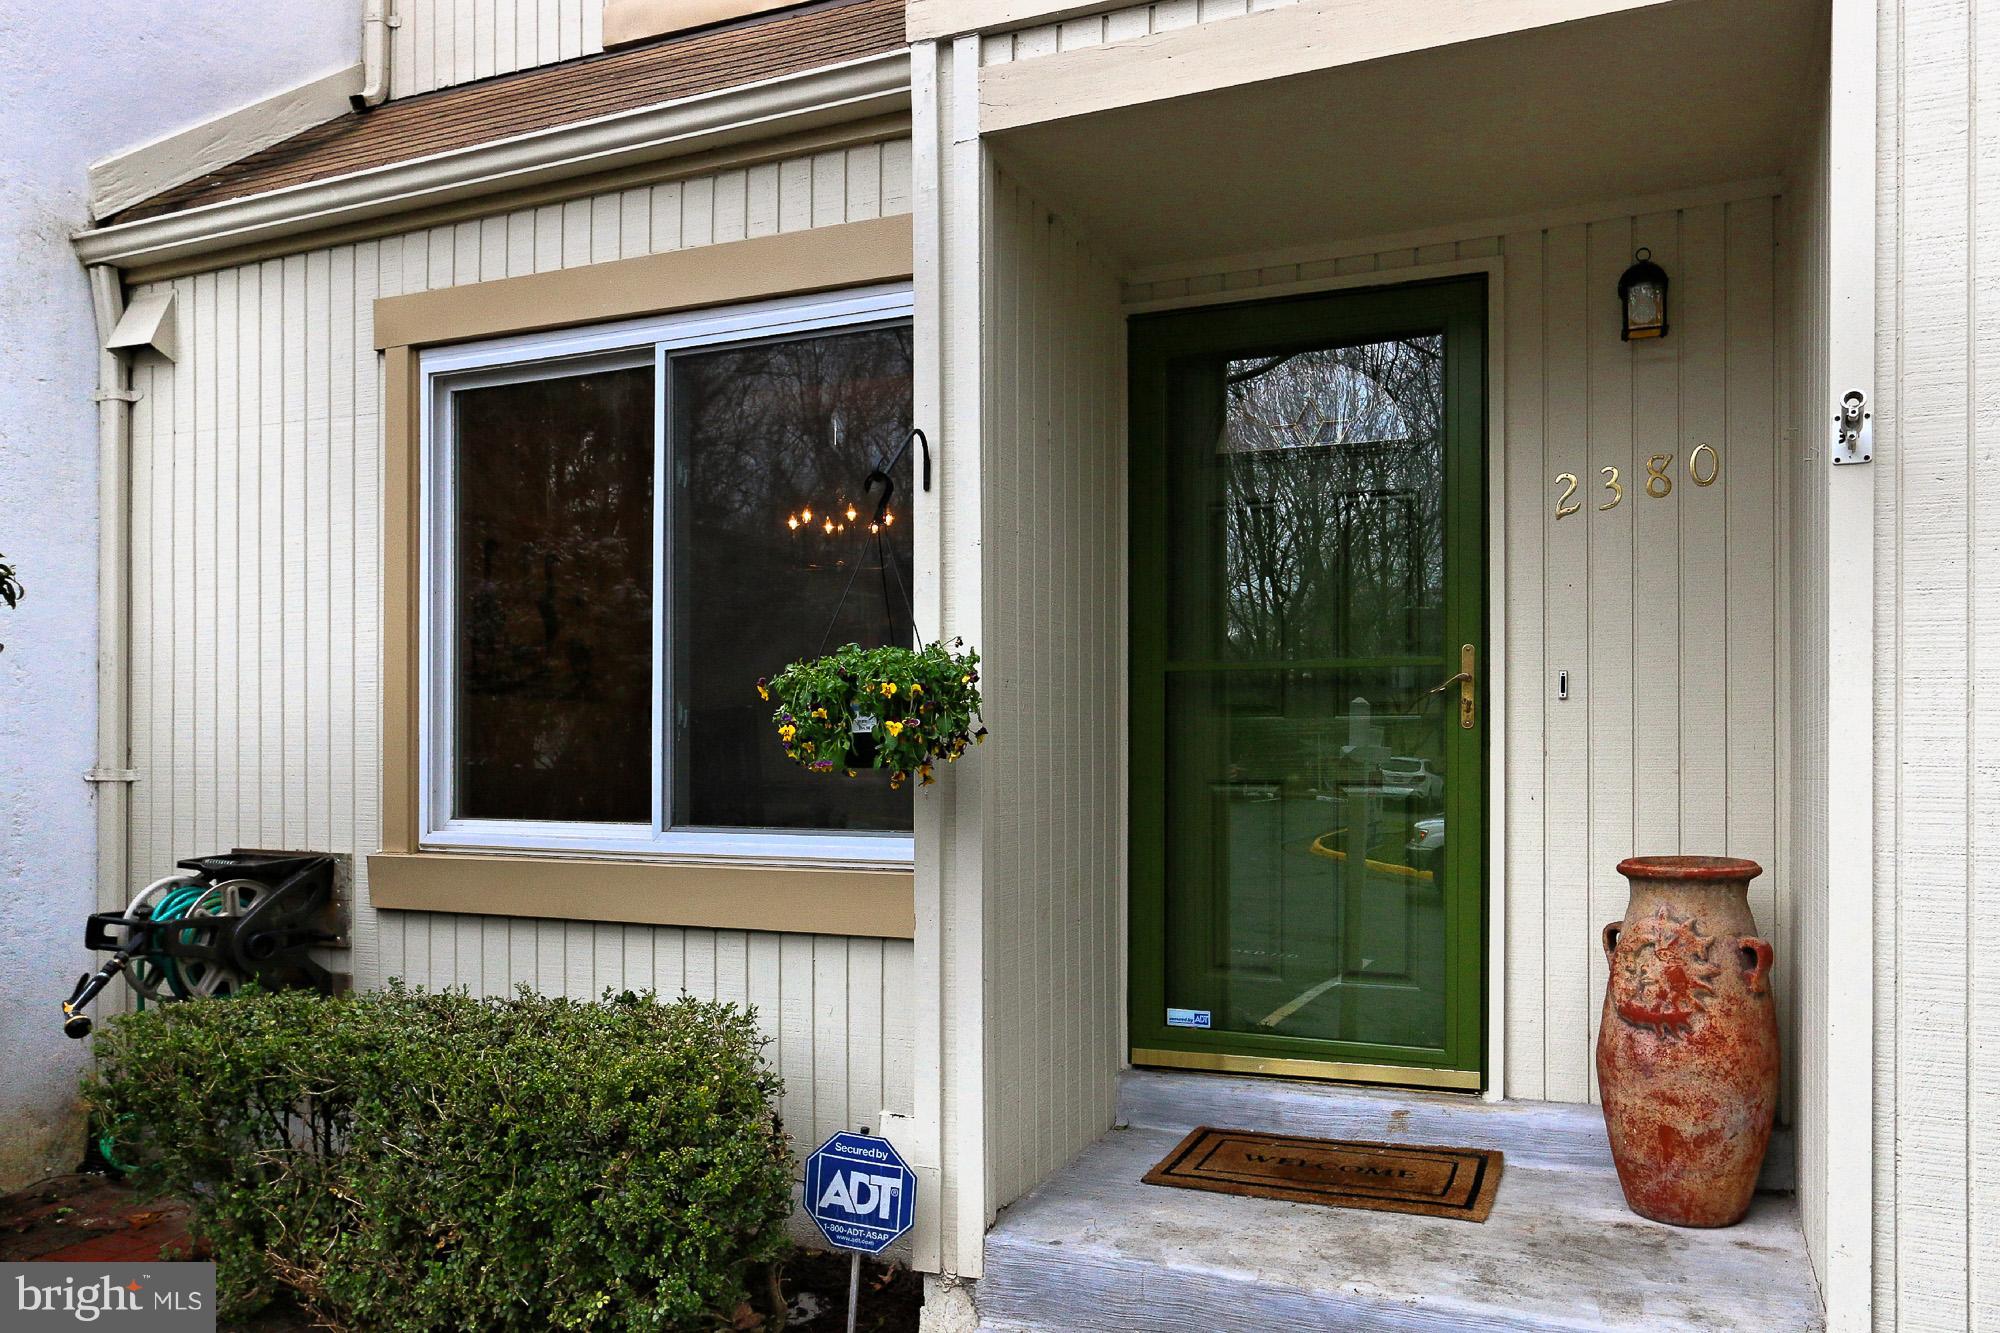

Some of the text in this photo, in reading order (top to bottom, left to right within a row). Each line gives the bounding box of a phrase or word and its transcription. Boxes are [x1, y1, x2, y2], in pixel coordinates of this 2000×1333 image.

[1554, 442, 1720, 521] 2380
[1194, 1015, 1209, 1024] ADT
[834, 1142, 889, 1161] Secured by
[1245, 1153, 1418, 1179] WELCOME
[818, 1169, 902, 1220] ADT
[824, 1223, 889, 1241] 1-800-ADT-ASAP
